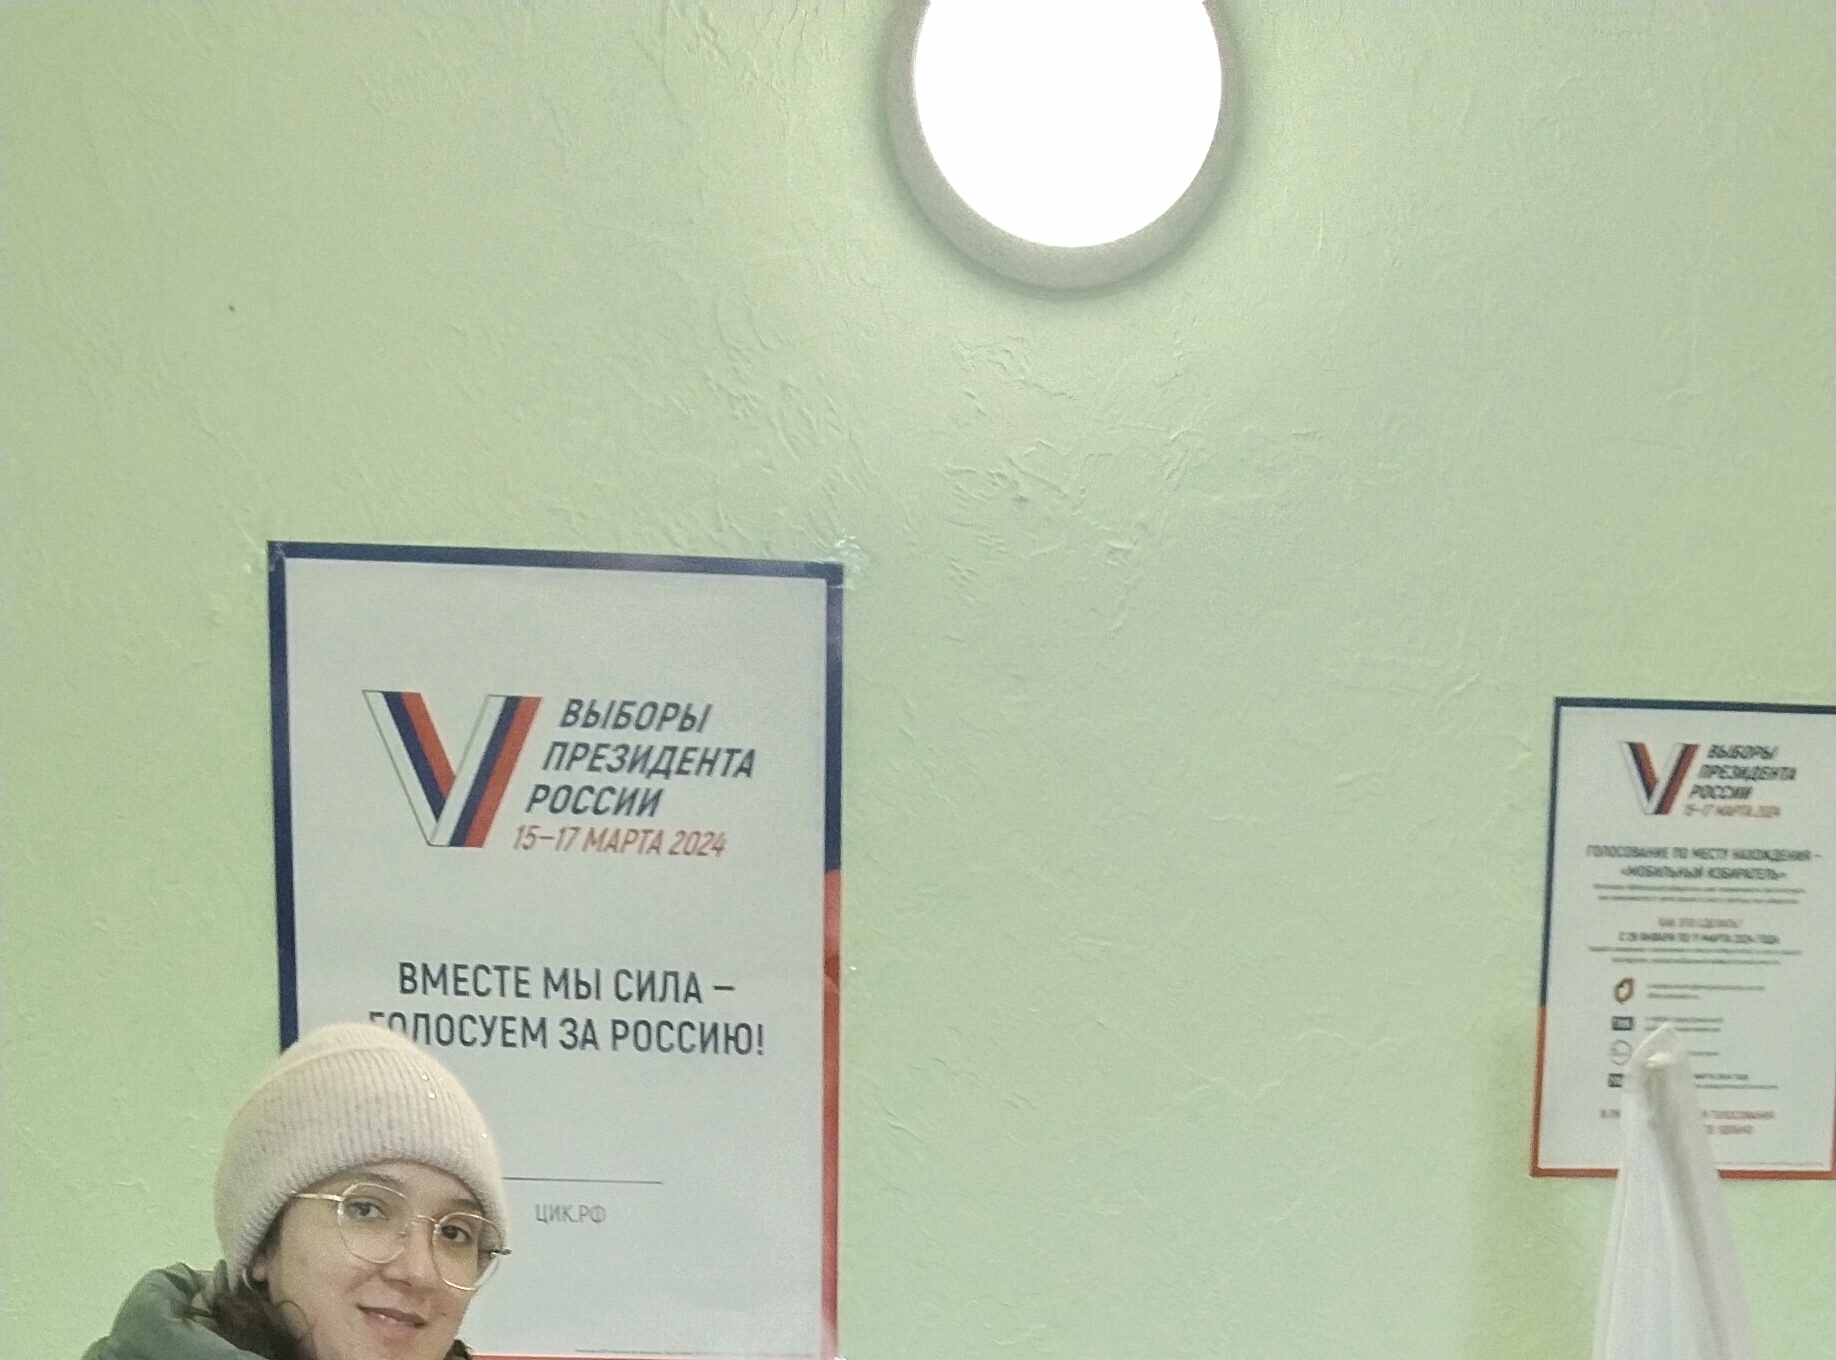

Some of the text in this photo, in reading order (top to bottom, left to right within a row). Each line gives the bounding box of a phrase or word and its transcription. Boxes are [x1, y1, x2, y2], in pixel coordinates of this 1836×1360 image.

[559, 698, 713, 733] ВЫБОРЫ
[542, 741, 756, 780] ПРЕЗИДЕНТА
[1706, 744, 1779, 759] ВЫБОРЫ
[526, 784, 664, 817] РОССИИ
[582, 826, 664, 855] МАРТА
[668, 830, 727, 857] 2024
[399, 962, 531, 998] ВМЕСТЕ
[543, 967, 600, 1001] МЫ
[614, 968, 703, 1004] СИЛА
[559, 1017, 600, 1051] ЗА
[611, 1018, 764, 1055] РОССИЮ!
[535, 1203, 606, 1224] ЦИК.РФ
